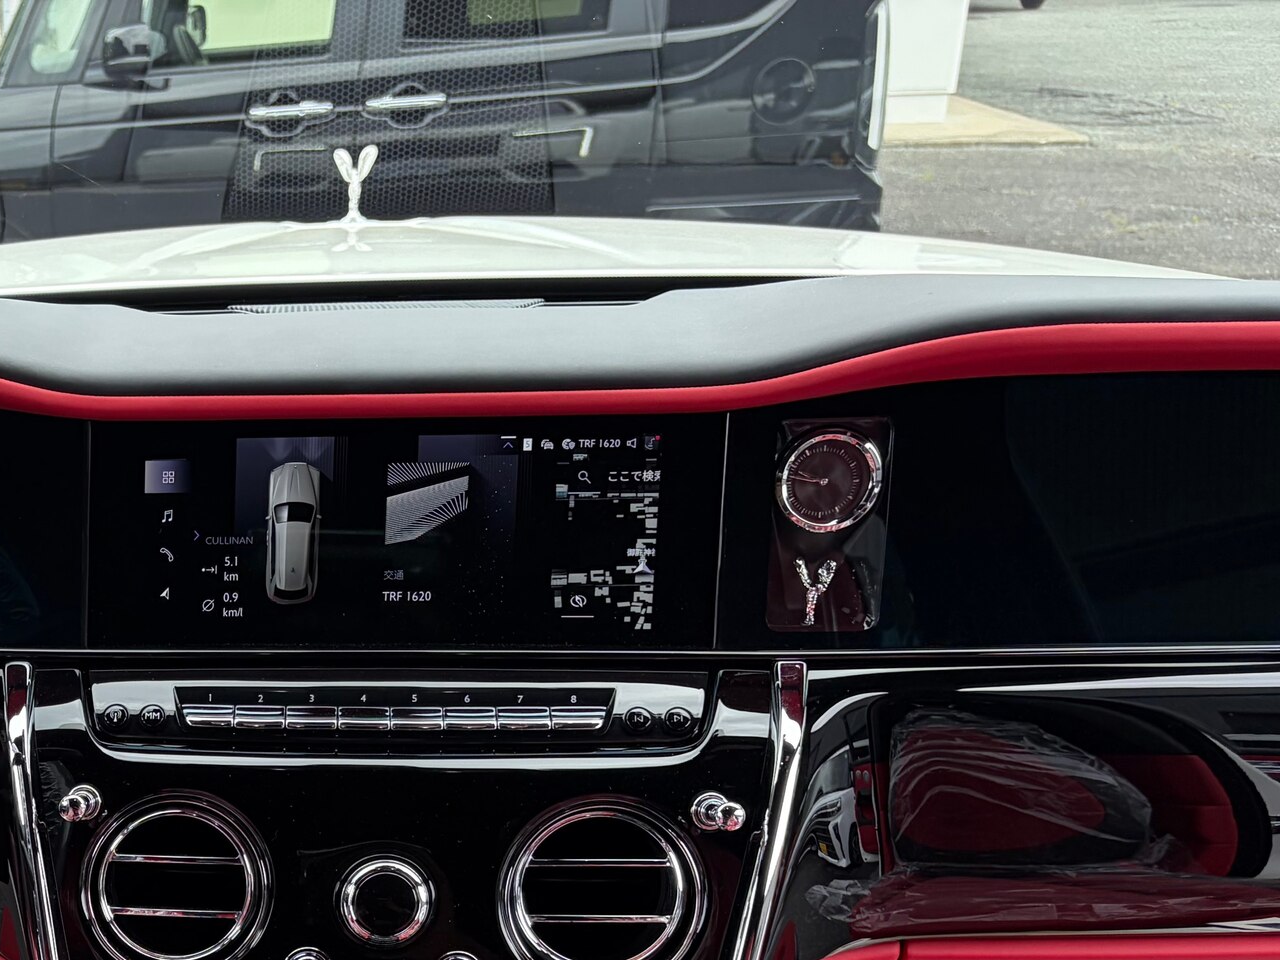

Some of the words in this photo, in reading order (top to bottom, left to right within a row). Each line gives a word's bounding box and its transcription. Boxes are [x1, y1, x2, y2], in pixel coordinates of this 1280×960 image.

[579, 439, 596, 448] TRF
[599, 439, 621, 448] 1620
[205, 536, 254, 545] CULLINAN
[223, 555, 238, 567] 5.1
[223, 571, 239, 581] km
[383, 569, 404, 581] 交通
[222, 592, 239, 603] 0.9
[382, 591, 403, 602] TRF
[407, 591, 432, 602] 1620
[222, 607, 244, 618] km/l
[258, 694, 264, 703] 2
[309, 694, 315, 703] 3
[360, 694, 367, 703] 4
[411, 694, 418, 703] 5
[464, 694, 471, 703] 6
[517, 695, 524, 704] 7
[570, 695, 577, 704] 8
[144, 711, 160, 720] MM
